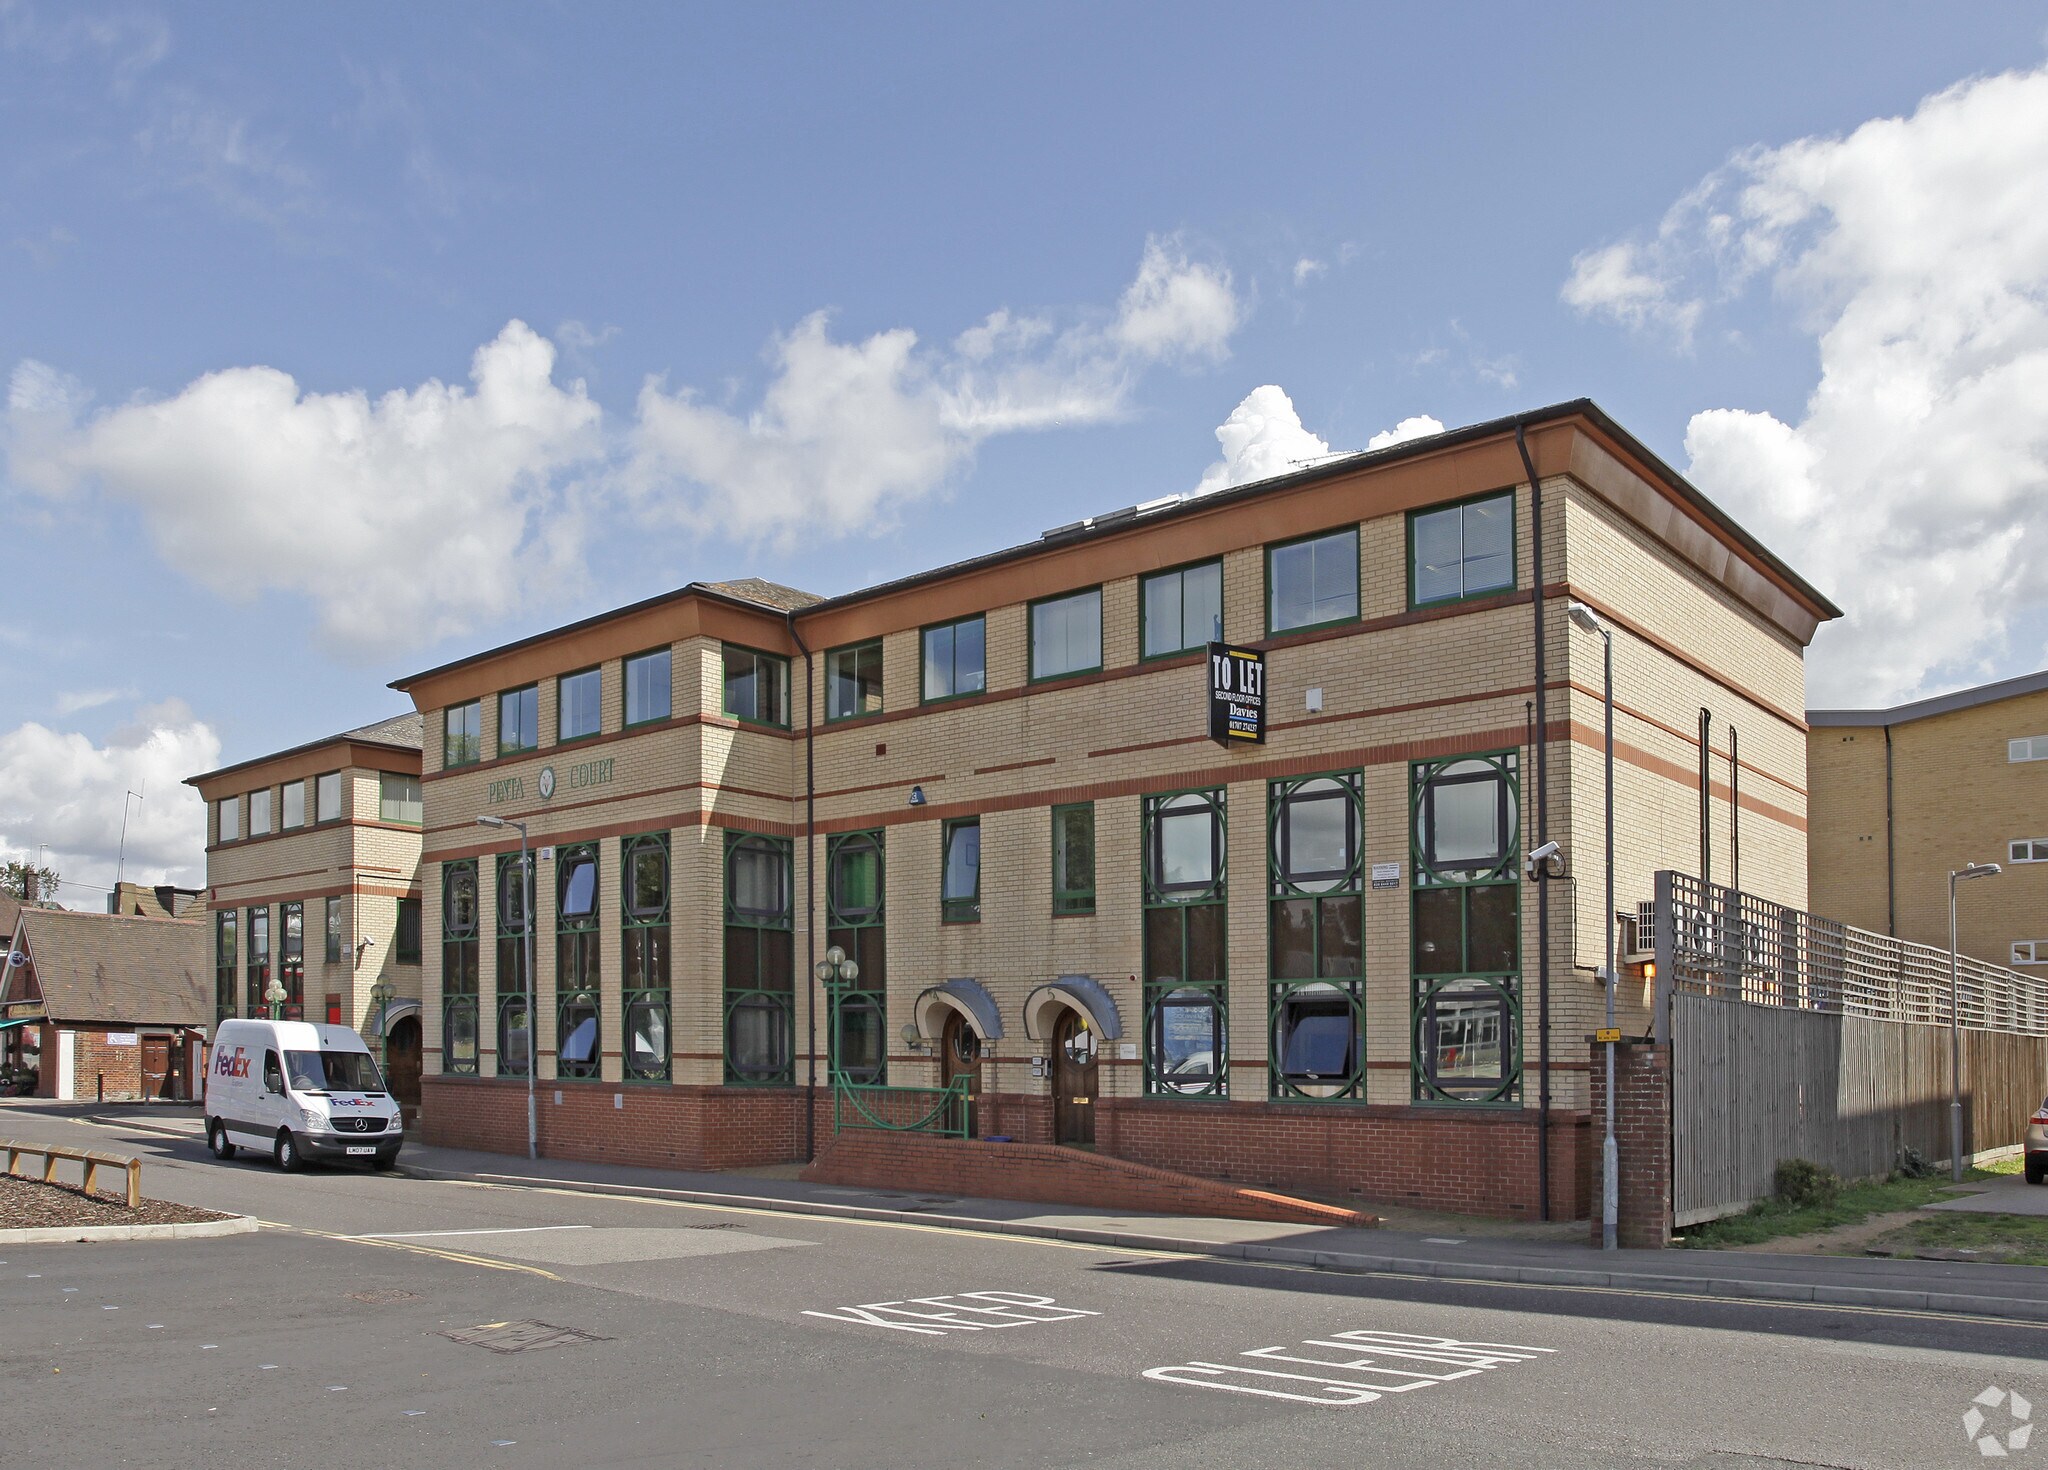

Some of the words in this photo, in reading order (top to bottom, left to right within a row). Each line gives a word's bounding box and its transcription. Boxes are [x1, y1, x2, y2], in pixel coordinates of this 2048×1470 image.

[1213, 655, 1231, 690] TO
[1239, 659, 1263, 696] LET
[1215, 690, 1231, 701] SECOND
[1231, 692, 1246, 703] FLOOR
[1245, 694, 1261, 706] OFFICES
[1229, 702, 1258, 719] Davies
[488, 777, 525, 804] PENTA
[569, 758, 615, 788] COURT
[214, 1045, 252, 1079] FedEx
[330, 1098, 376, 1107] FedEx
[801, 1290, 1103, 1335] KEEP
[1142, 1329, 1559, 1405] CLEAR
